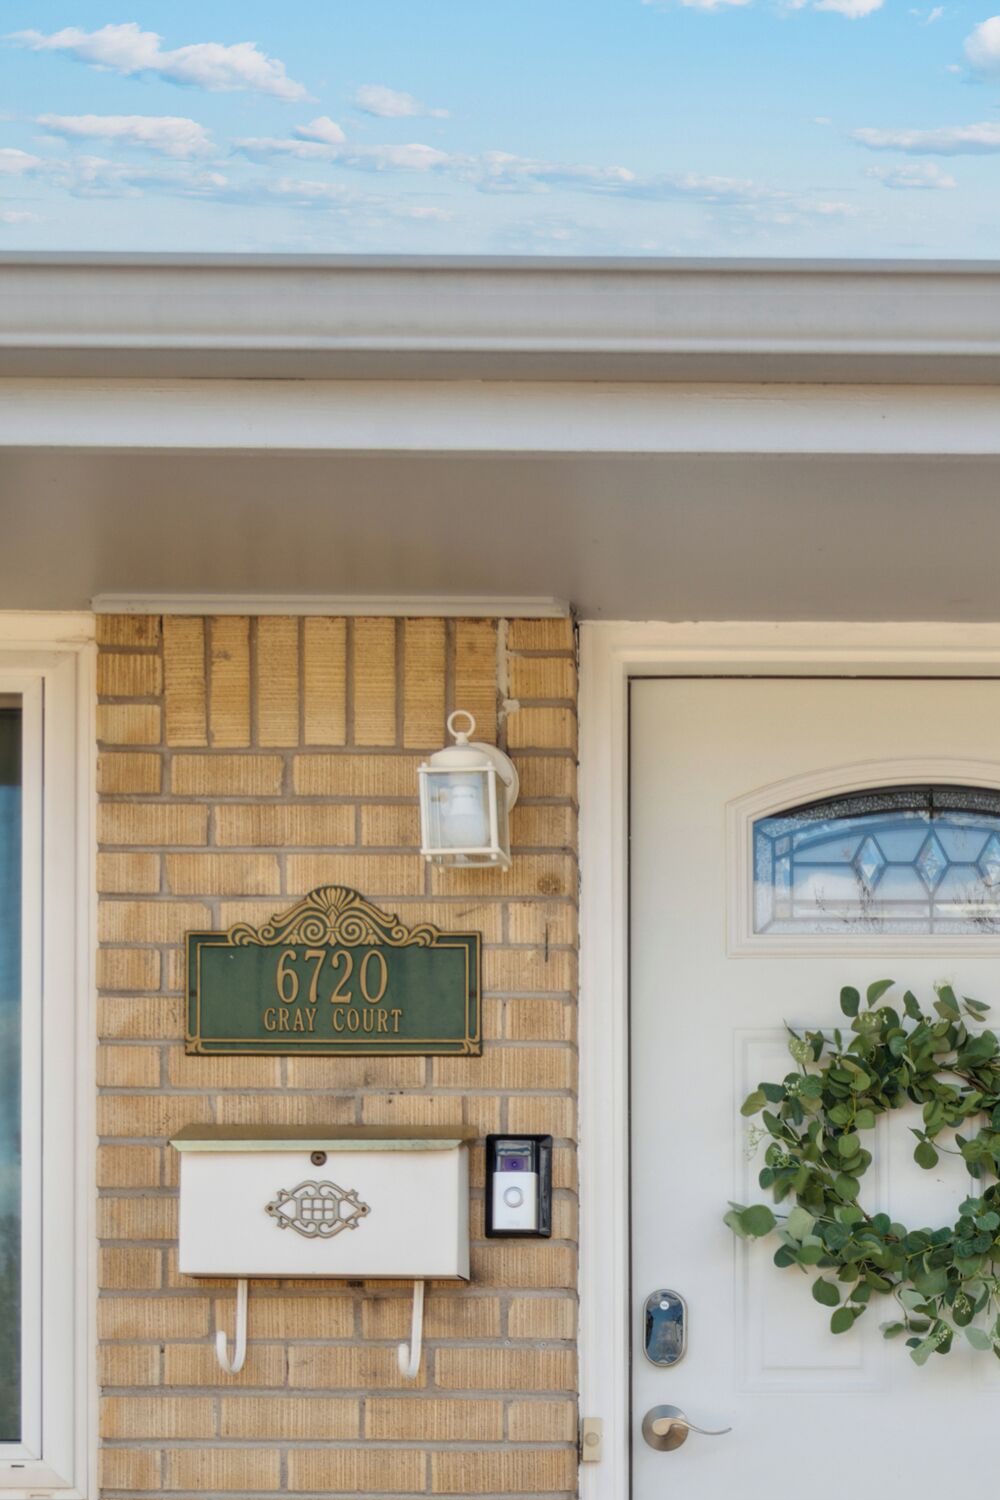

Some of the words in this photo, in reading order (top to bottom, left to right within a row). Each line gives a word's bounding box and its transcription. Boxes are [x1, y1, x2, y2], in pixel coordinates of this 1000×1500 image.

[276, 949, 389, 1004] 6720
[263, 1007, 317, 1032] GRAY
[332, 1008, 403, 1033] COURT
